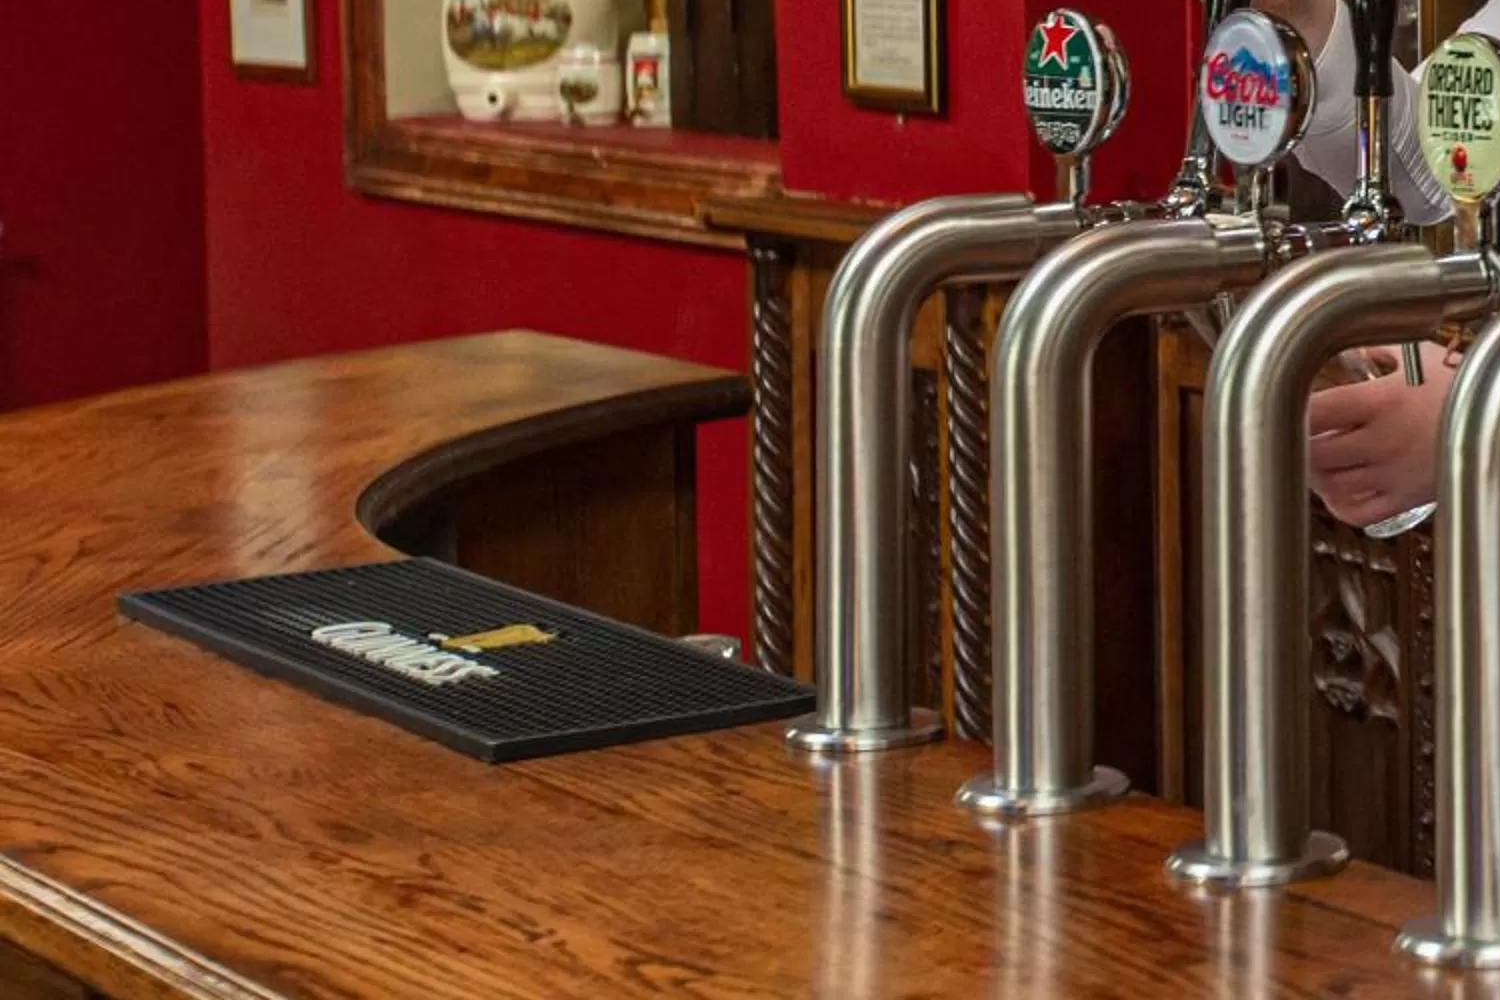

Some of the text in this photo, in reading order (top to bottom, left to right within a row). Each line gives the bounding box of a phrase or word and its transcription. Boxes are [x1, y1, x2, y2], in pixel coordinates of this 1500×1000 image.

[1024, 80, 1098, 110] eineken
[1207, 52, 1280, 106] Coors
[1427, 63, 1493, 96] ORCHARD
[1218, 103, 1265, 130] LIGHT
[1428, 94, 1493, 131] THIEVES
